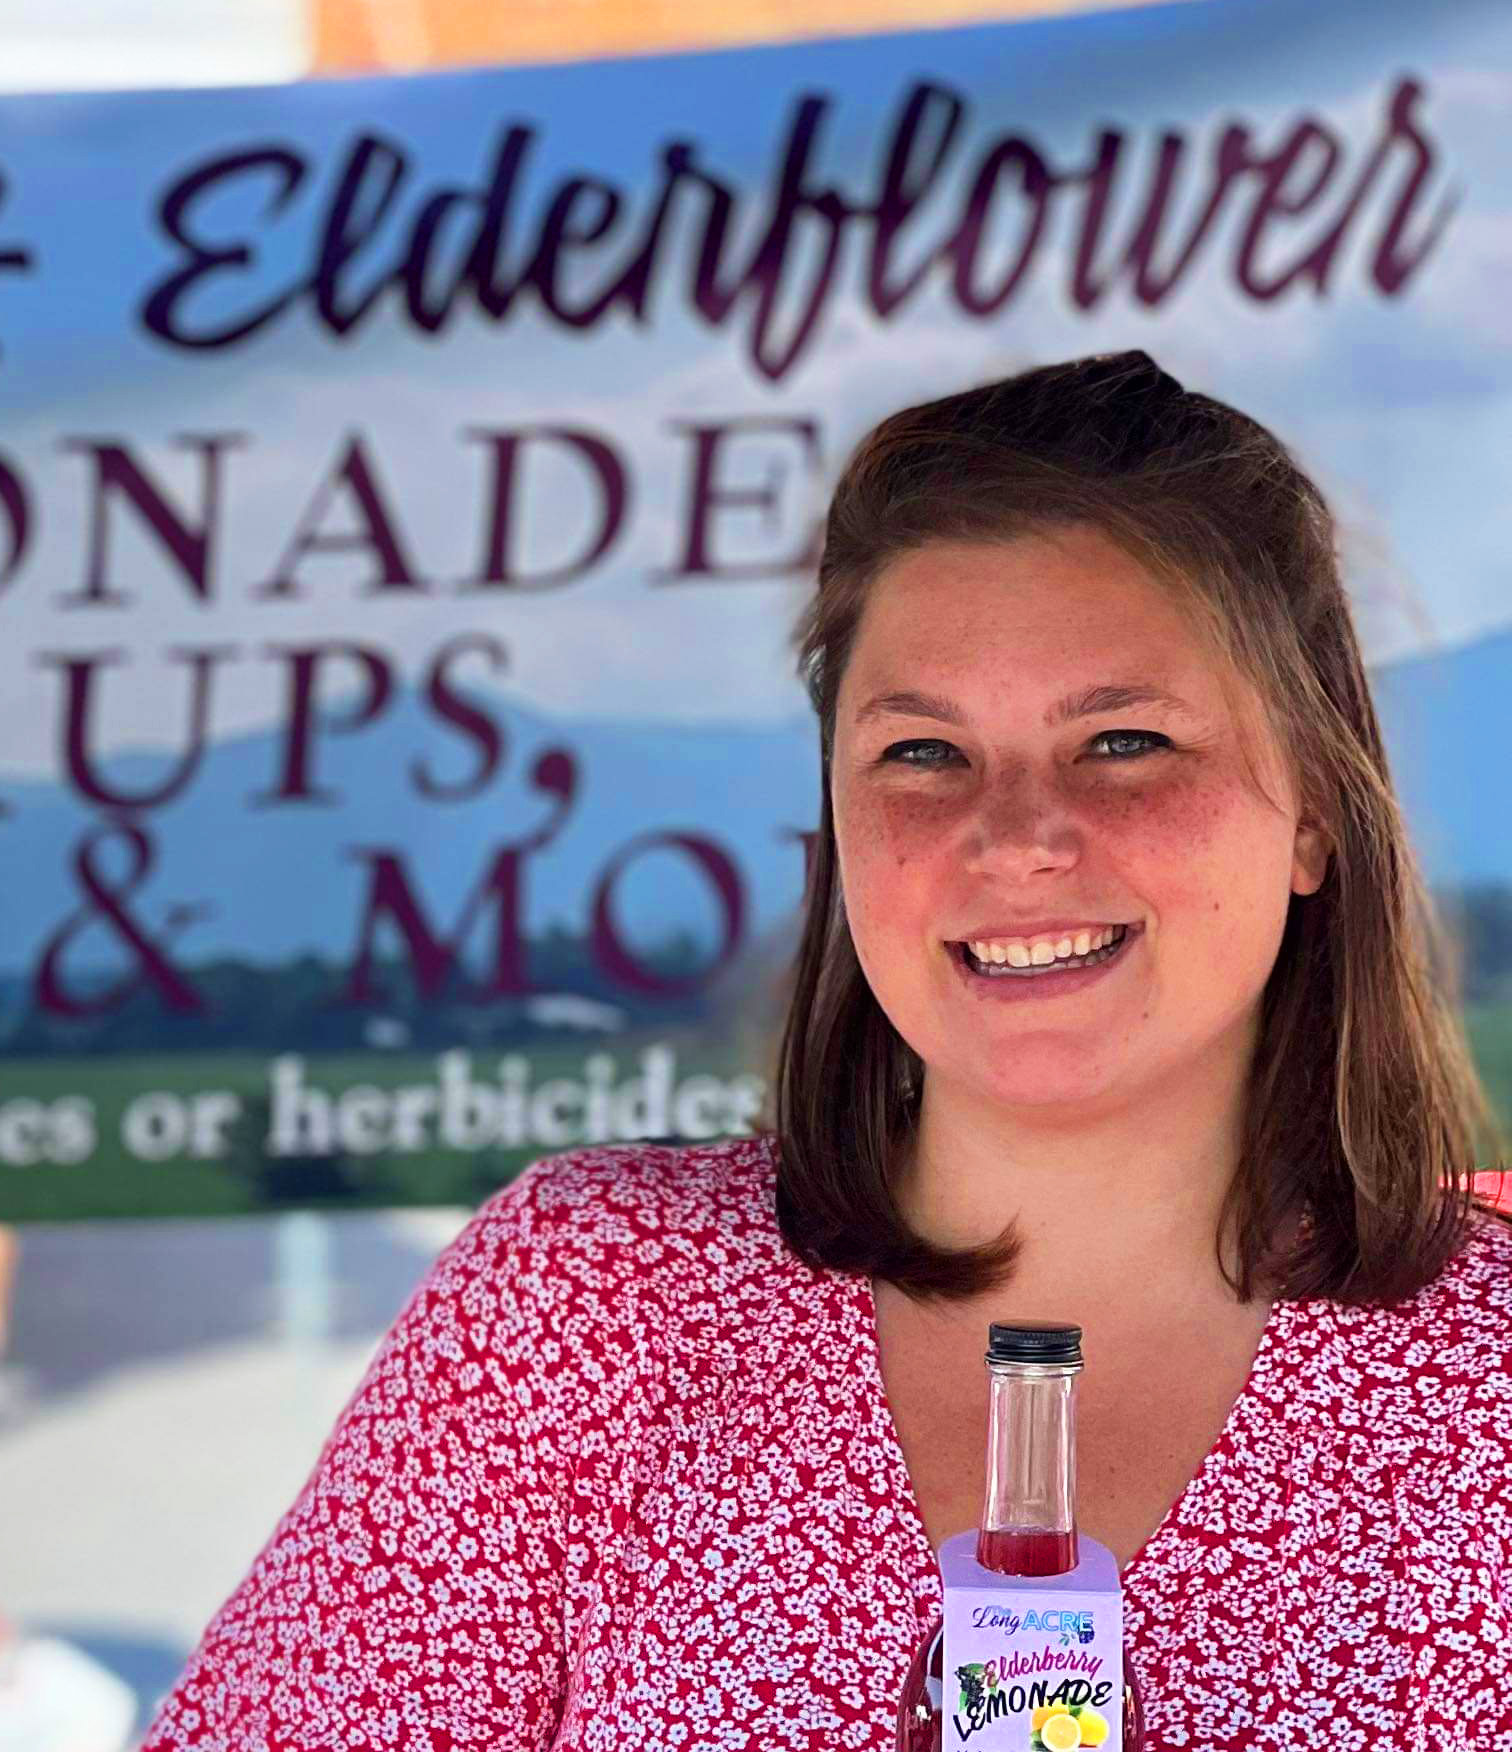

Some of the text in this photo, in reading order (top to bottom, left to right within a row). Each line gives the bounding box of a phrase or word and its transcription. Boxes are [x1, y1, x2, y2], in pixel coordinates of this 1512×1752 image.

[137, 76, 1462, 382] Elderflower
[30, 811, 213, 1018] &
[342, 826, 820, 1012] MO
[122, 1090, 240, 1160] or
[264, 1042, 765, 1158] herbicides
[972, 1605, 1093, 1636] Long ACRE
[953, 1679, 1113, 1742] LEMONADE
